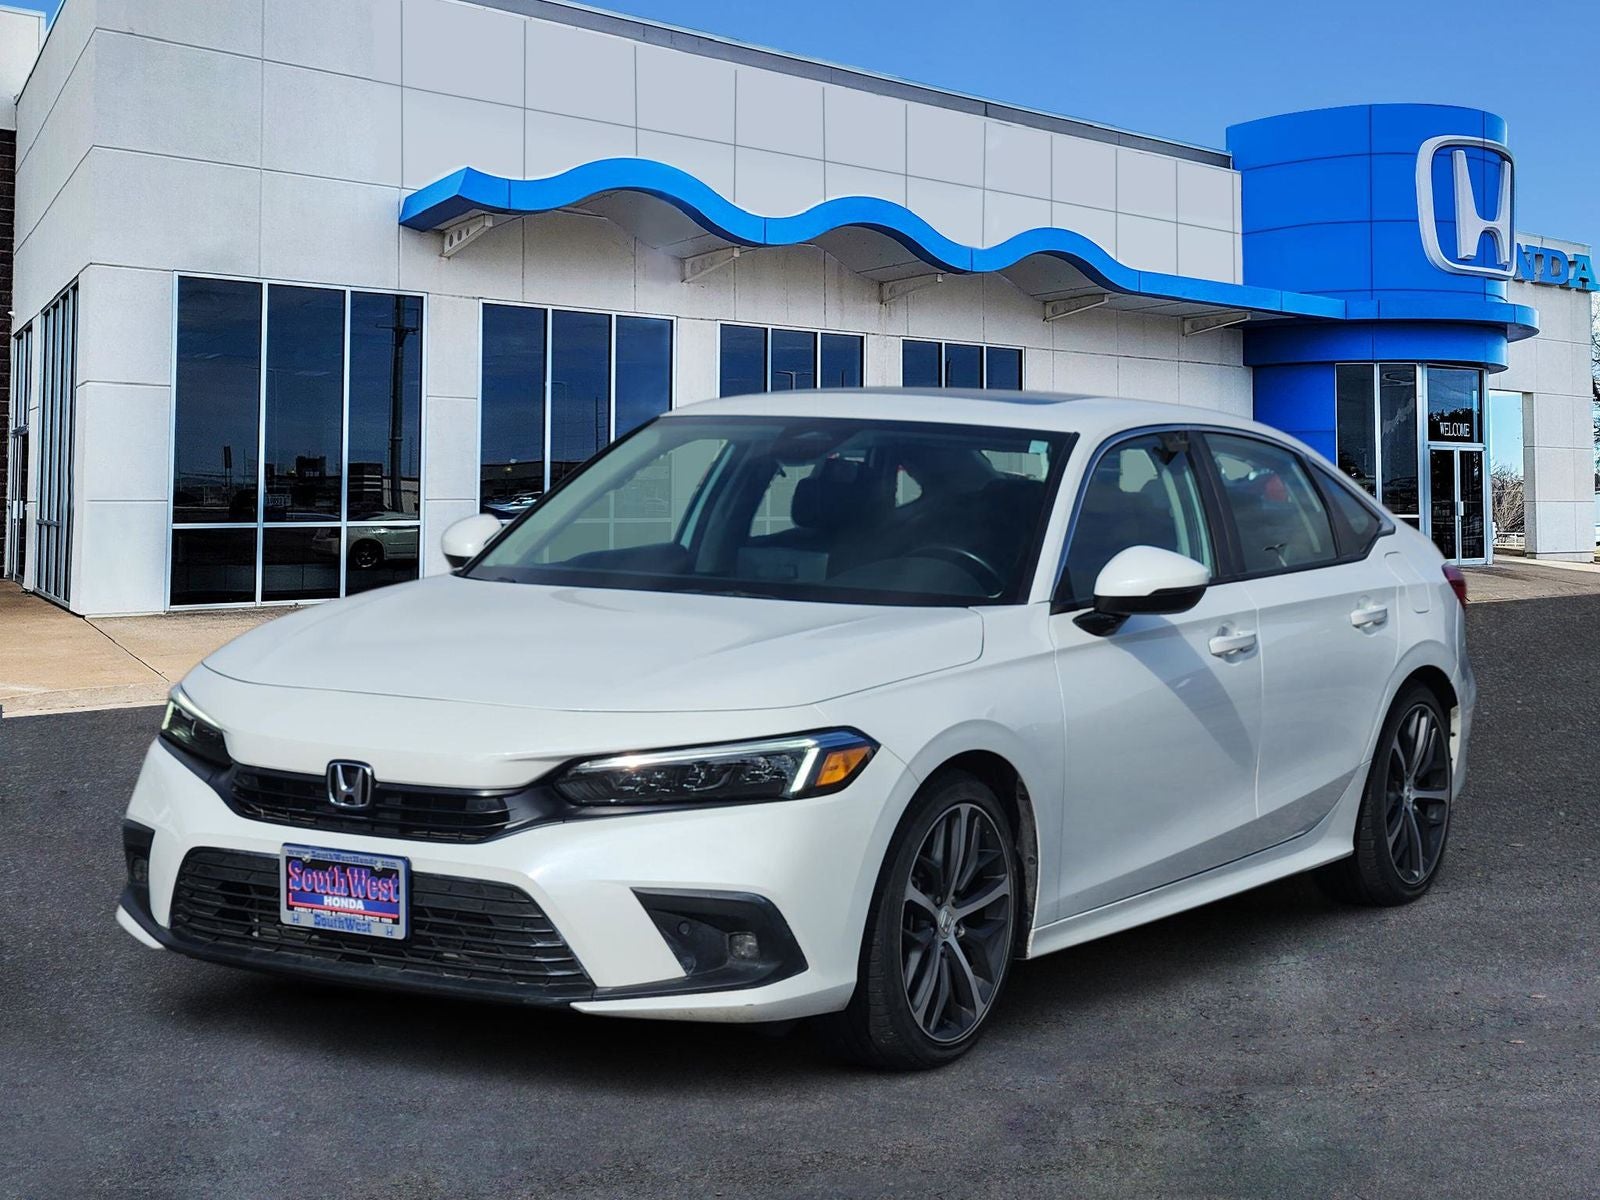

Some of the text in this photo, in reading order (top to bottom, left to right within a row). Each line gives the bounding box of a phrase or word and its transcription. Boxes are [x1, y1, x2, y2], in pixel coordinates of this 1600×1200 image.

[1513, 242, 1600, 292] NDA
[1439, 421, 1471, 438] WELCOME
[286, 848, 398, 869] www.SouthWestHondacom
[288, 859, 400, 903] SouthWest
[323, 895, 365, 911] HONDA
[313, 912, 372, 934] SouthWest
